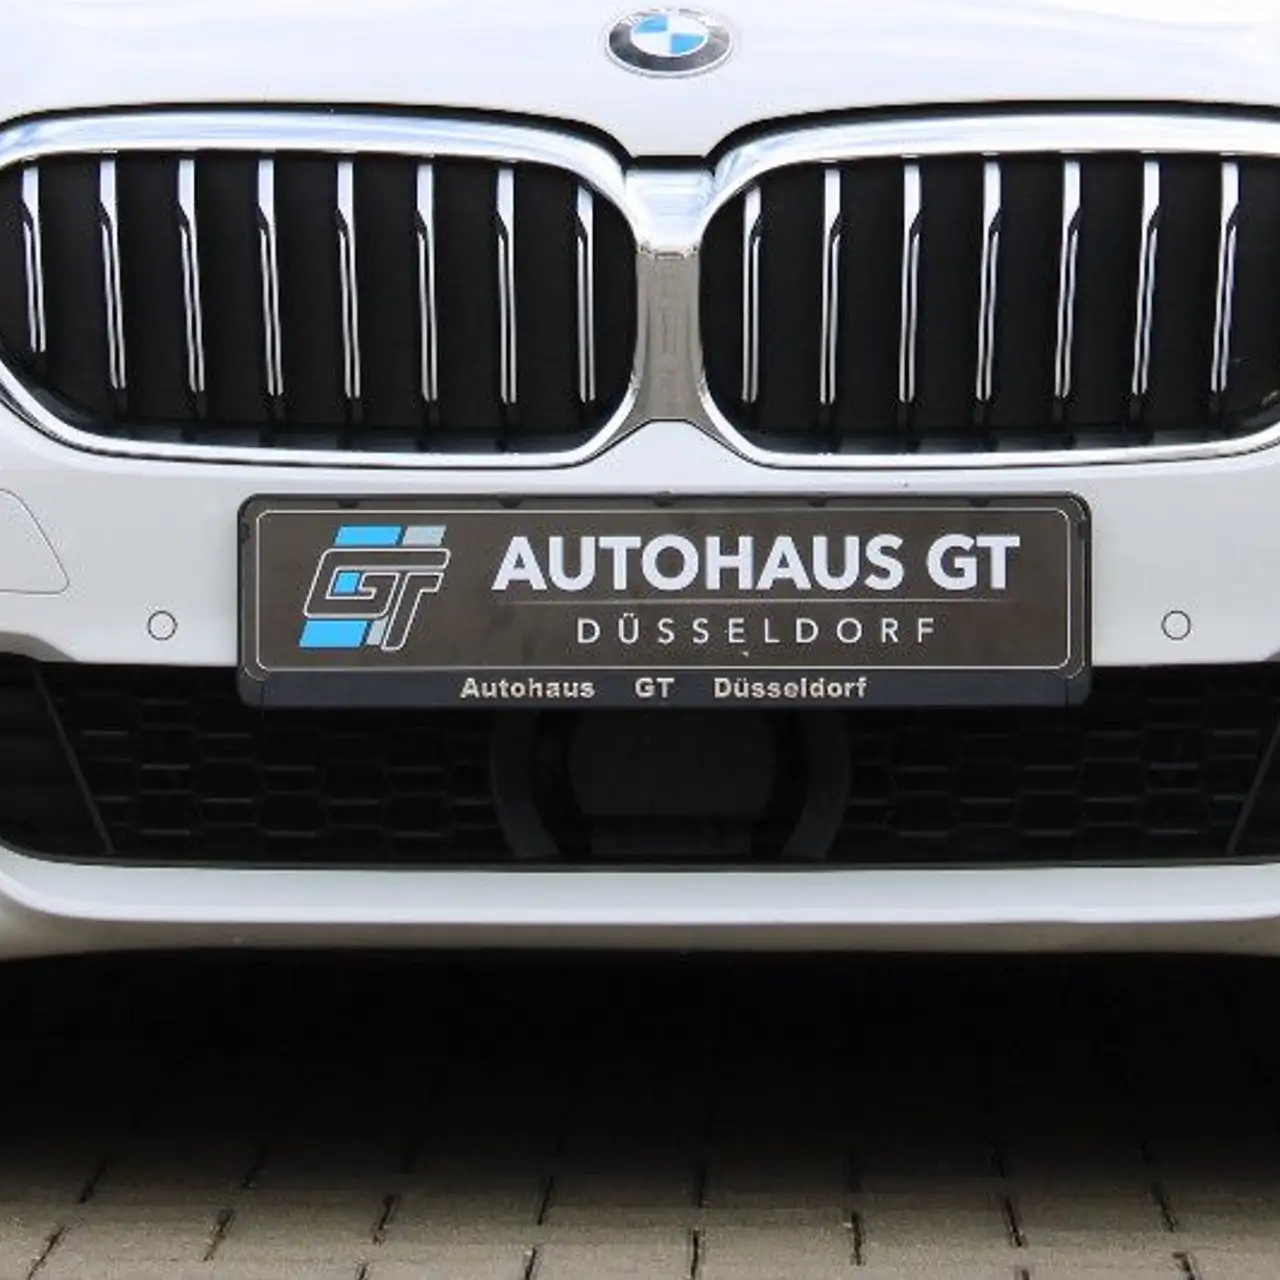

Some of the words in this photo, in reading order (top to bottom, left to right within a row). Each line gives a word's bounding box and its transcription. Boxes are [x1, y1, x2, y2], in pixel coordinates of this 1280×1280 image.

[492, 534, 904, 591] AUTOHAUS
[926, 534, 1020, 591] GT
[578, 613, 935, 645] DÜSSELDORF
[460, 677, 596, 699] Autohaus
[634, 677, 675, 699] GT
[713, 676, 867, 699] Düsseldorf
